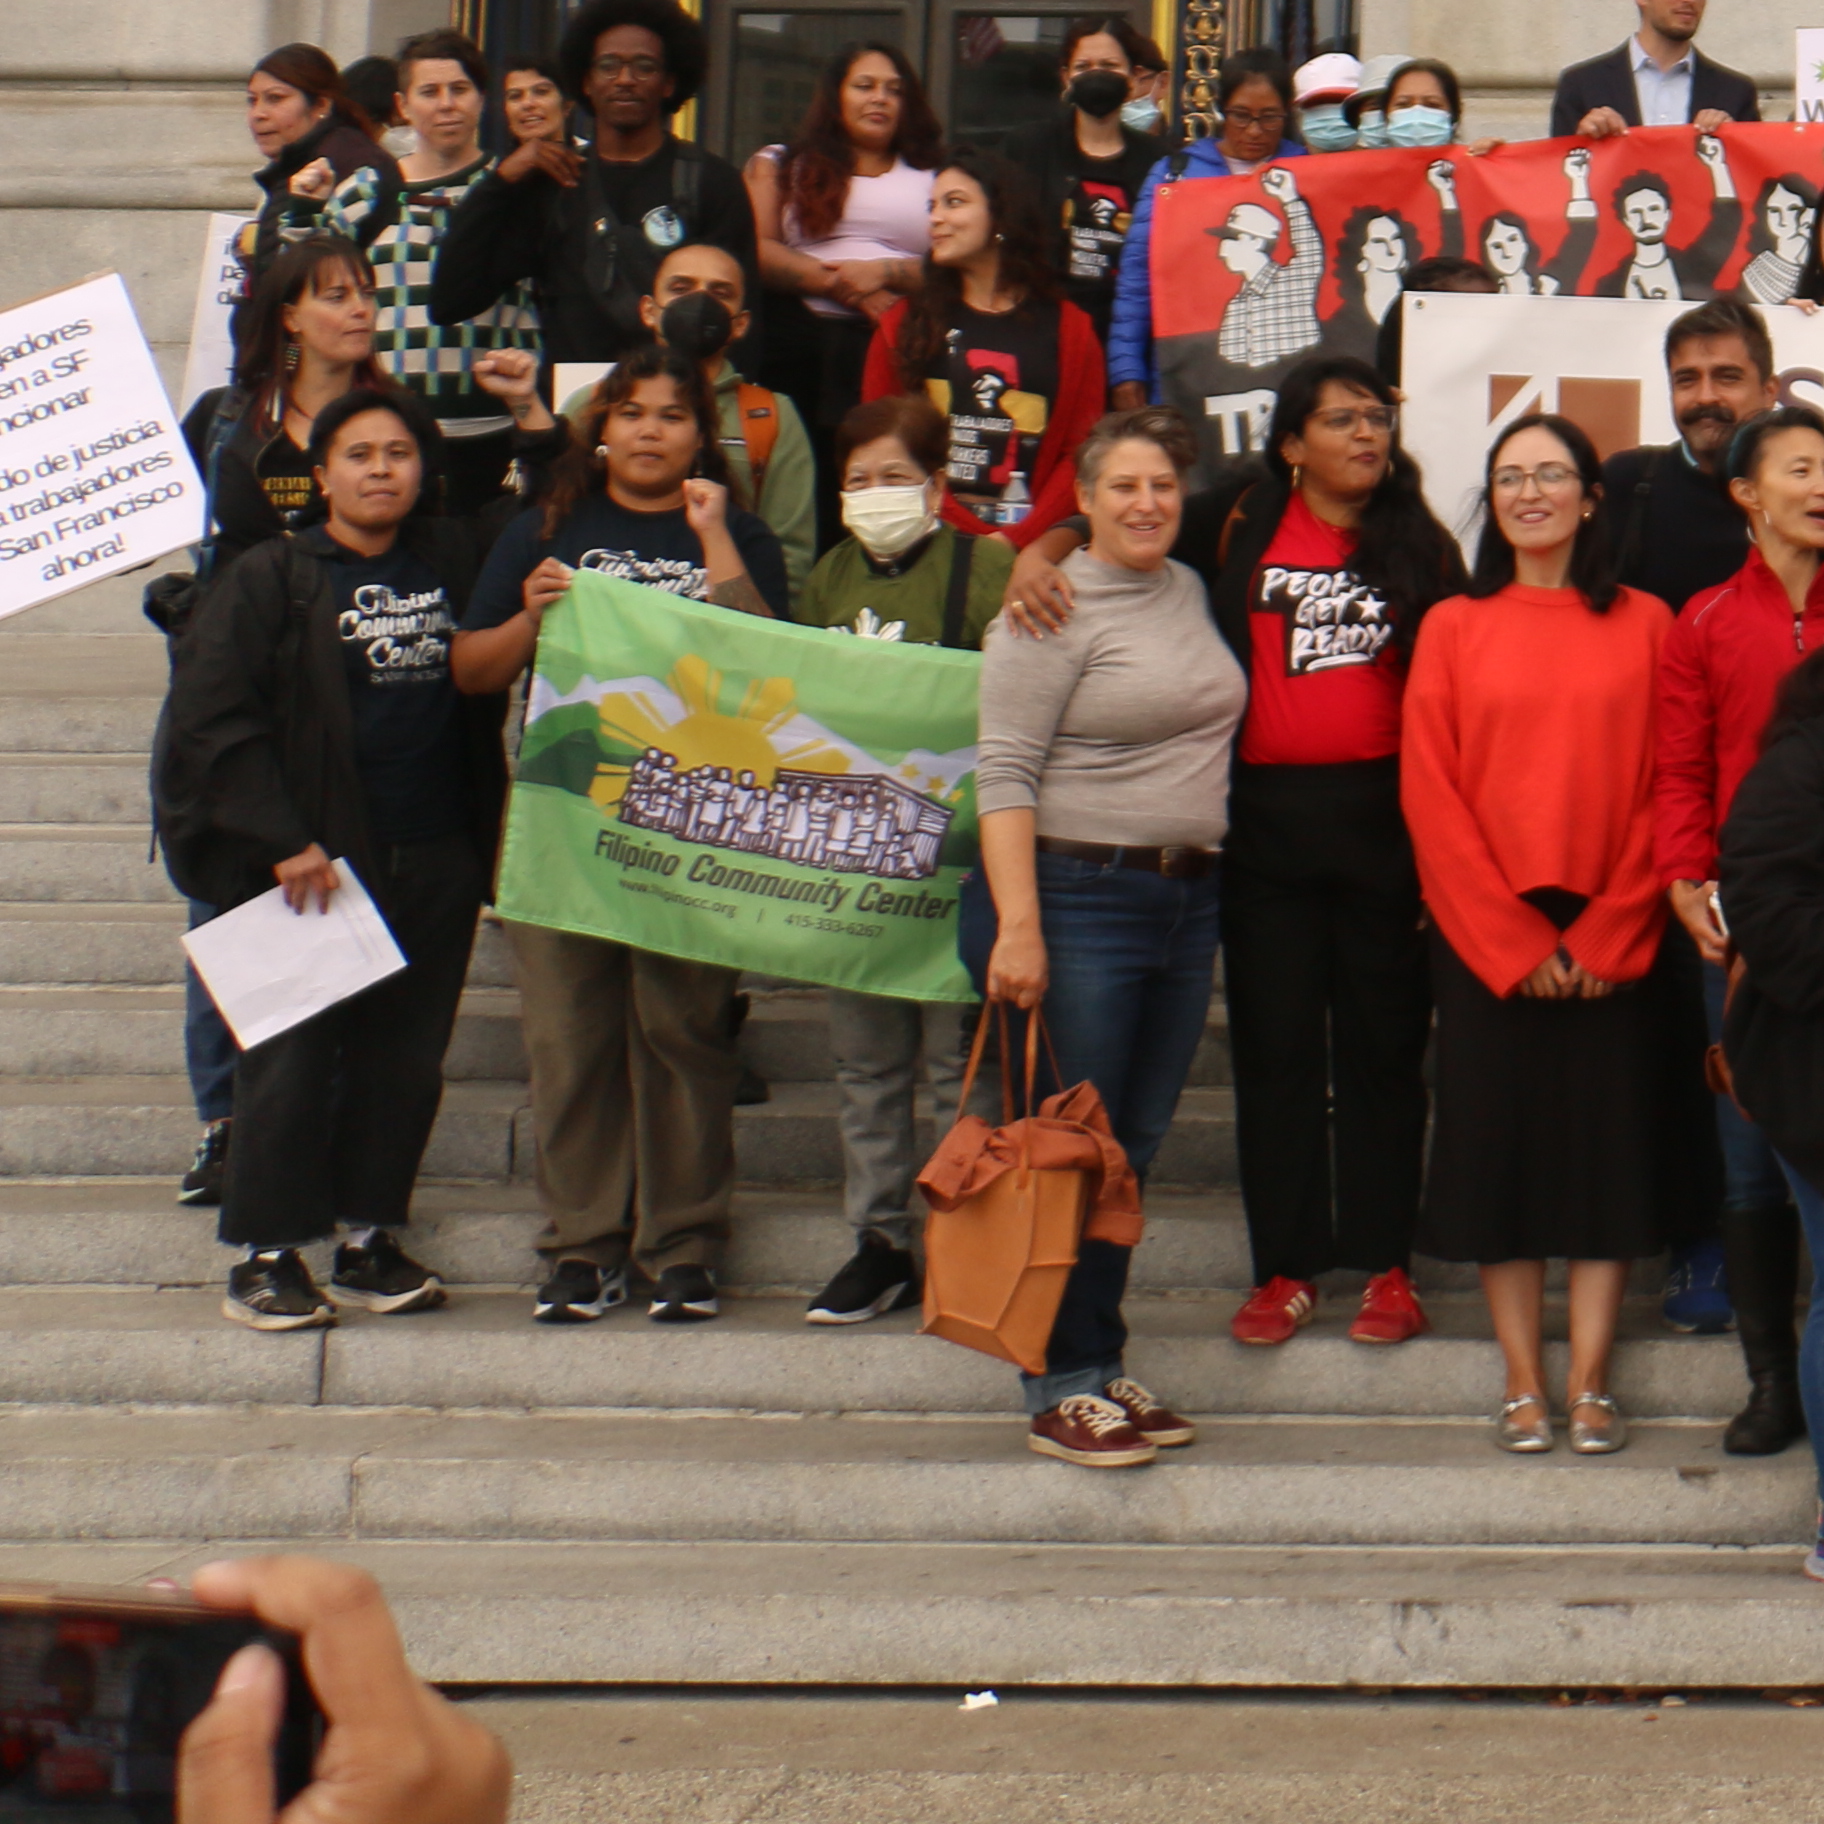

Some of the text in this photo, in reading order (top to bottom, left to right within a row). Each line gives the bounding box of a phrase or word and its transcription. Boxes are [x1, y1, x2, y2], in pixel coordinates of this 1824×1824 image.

[31, 369, 52, 387] a
[51, 348, 91, 379] SF
[34, 454, 69, 479] de
[69, 420, 165, 472] justicia
[8, 450, 174, 522] trabajadores
[53, 480, 185, 542] Francisco
[41, 531, 127, 582] ahora!
[1294, 585, 1369, 628] GET
[1291, 622, 1393, 670] READY
[594, 828, 960, 920] Filipino Community Center
